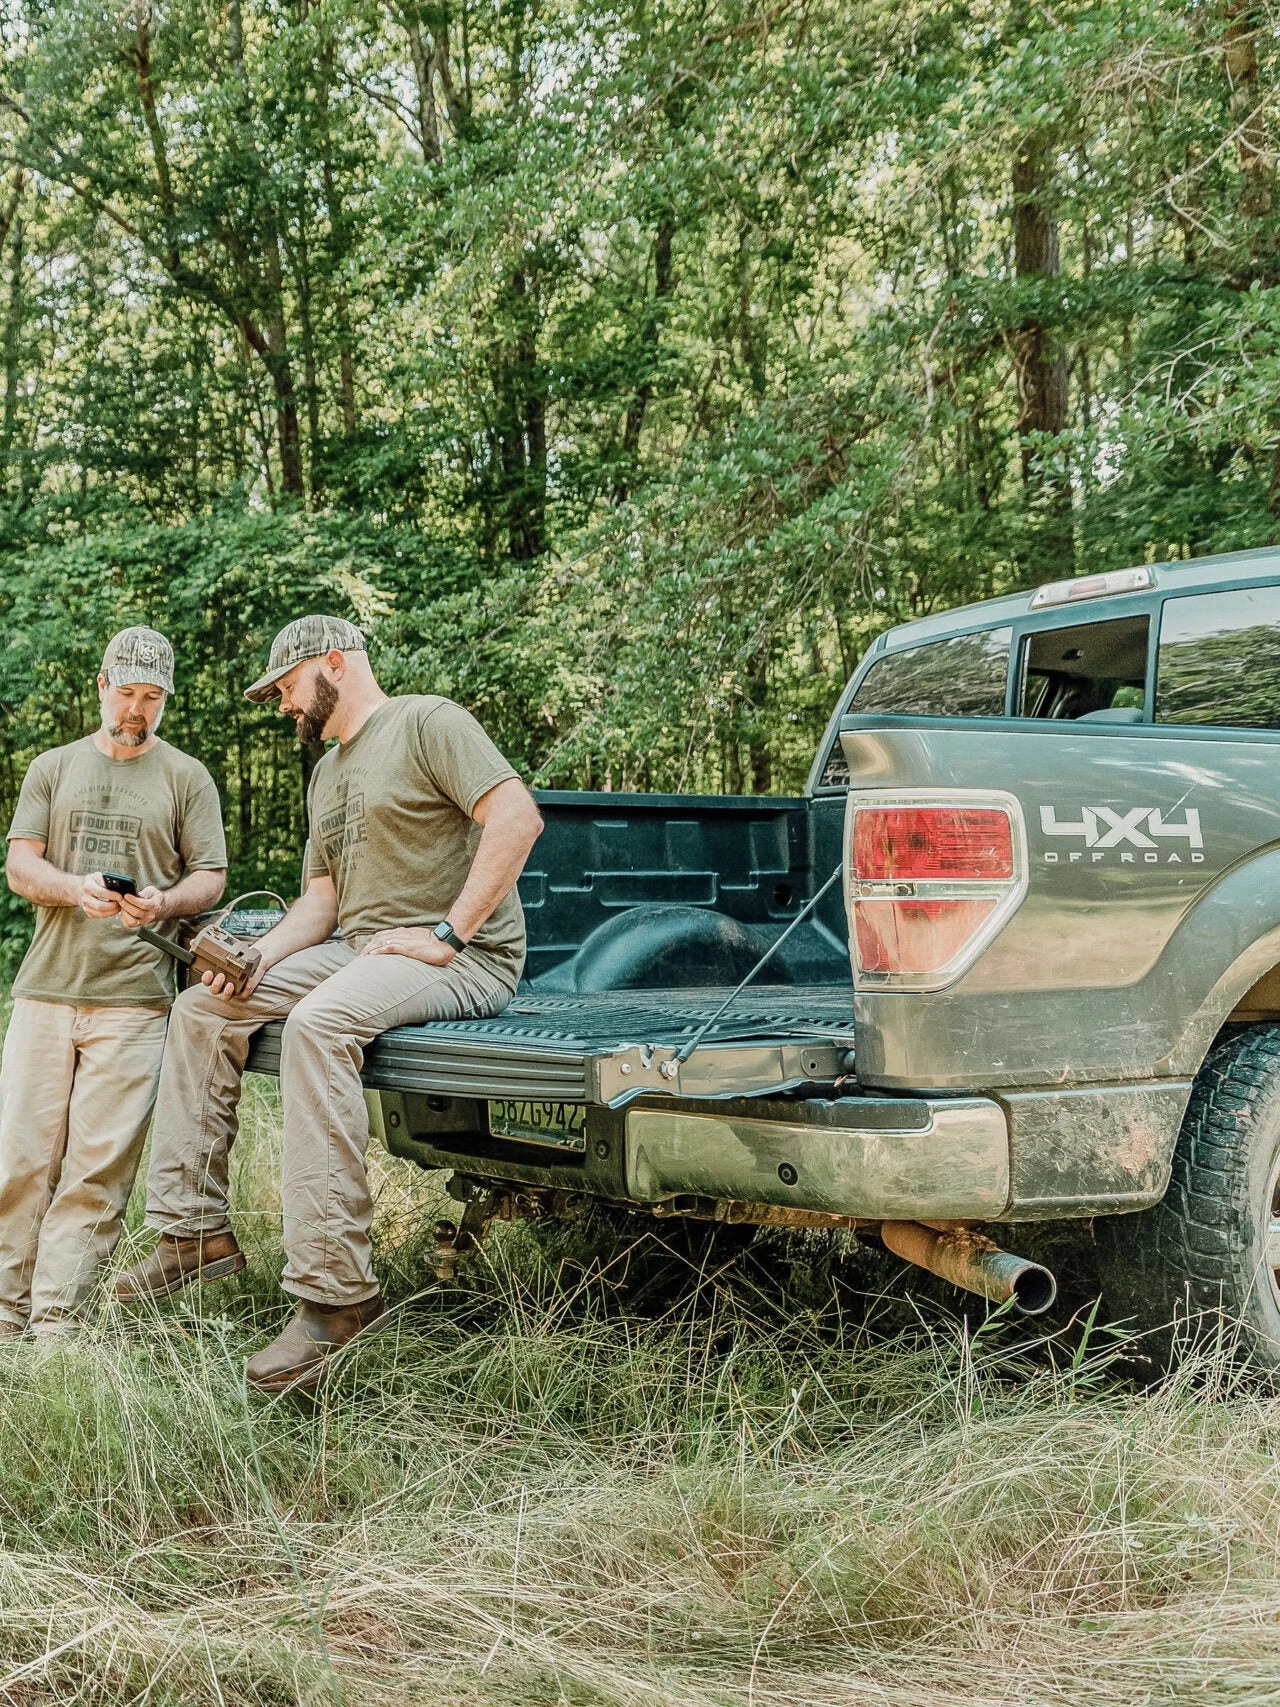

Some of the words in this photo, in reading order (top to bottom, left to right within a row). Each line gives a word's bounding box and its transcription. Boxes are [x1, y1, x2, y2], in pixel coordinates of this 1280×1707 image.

[75, 815, 137, 833] MOULTRIE
[320, 800, 361, 833] MOURIE
[1039, 805, 1204, 848] 4X4
[70, 835, 137, 859] MOBILE
[1044, 852, 1105, 863] OFF
[1120, 852, 1205, 863] ROAD
